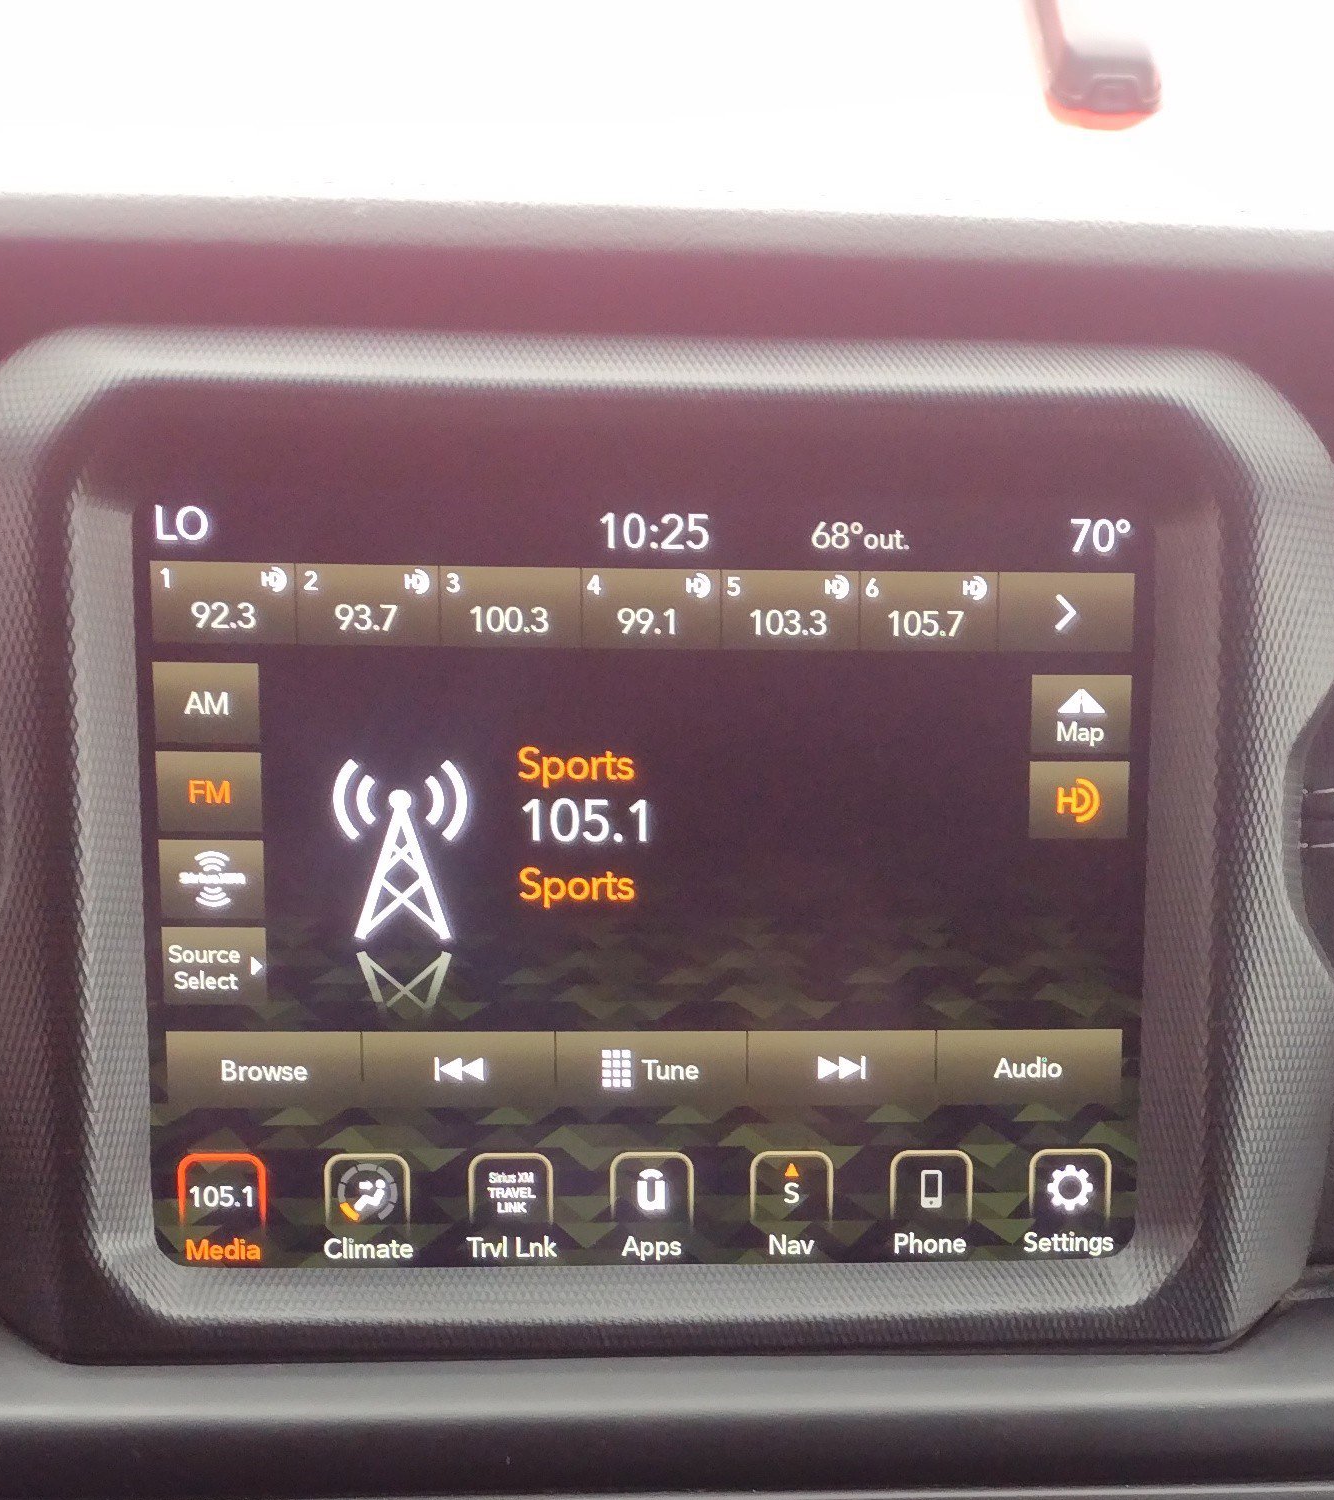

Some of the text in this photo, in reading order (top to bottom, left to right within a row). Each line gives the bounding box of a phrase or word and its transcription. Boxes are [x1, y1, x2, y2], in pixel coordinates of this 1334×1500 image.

[155, 505, 209, 541] LO
[601, 512, 710, 551] 10:25
[1070, 518, 1131, 553] 70°
[159, 567, 171, 589] 1
[303, 570, 319, 591] 2
[446, 572, 461, 593] 3
[586, 575, 602, 595] 4
[726, 576, 741, 597] 5
[865, 577, 880, 598] 6
[190, 602, 257, 630] 92.3
[334, 604, 398, 632] 93.7
[470, 606, 550, 634] 100.3
[617, 608, 678, 635] 99.1
[749, 610, 828, 636] 103.3
[887, 611, 965, 637] 105.7
[184, 692, 230, 715] AM
[1056, 721, 1104, 746] Map
[517, 746, 636, 788] Sports
[188, 780, 231, 803] FM
[522, 798, 650, 842] 105.1
[518, 866, 636, 908] Sports
[168, 945, 241, 965] Source
[174, 970, 238, 991] Select
[221, 1060, 308, 1083] Browse
[642, 1060, 699, 1081] Tune
[993, 1056, 1063, 1080] Audio
[190, 1186, 254, 1208] 105.1
[487, 1186, 537, 1199] TRAVEL
[783, 1182, 800, 1204] S
[497, 1201, 527, 1214] LINK
[185, 1239, 261, 1261] Media
[323, 1238, 414, 1260] Climate
[466, 1236, 557, 1259] Trvl Lnk
[622, 1237, 682, 1264] Apps
[769, 1235, 814, 1256] Nav
[894, 1232, 967, 1254] Phone
[1024, 1232, 1114, 1259] Settings
